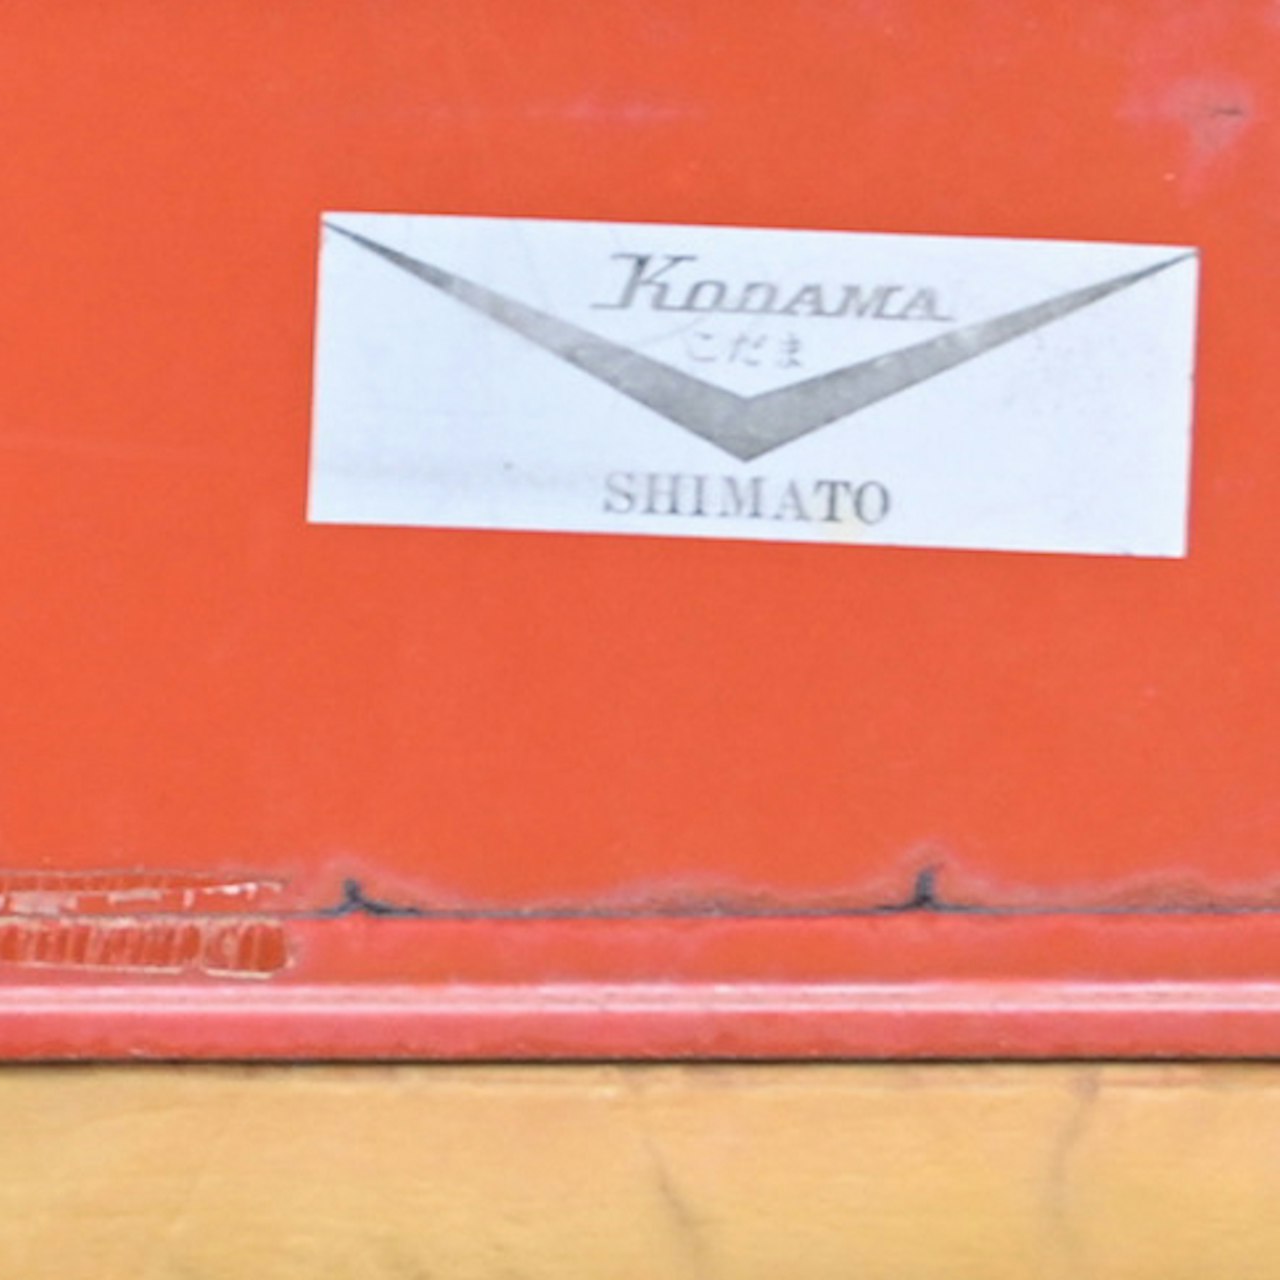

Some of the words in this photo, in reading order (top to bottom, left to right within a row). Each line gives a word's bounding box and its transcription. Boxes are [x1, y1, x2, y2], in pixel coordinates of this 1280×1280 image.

[685, 330, 806, 369] こだま
[602, 470, 892, 526] SHIMATO
